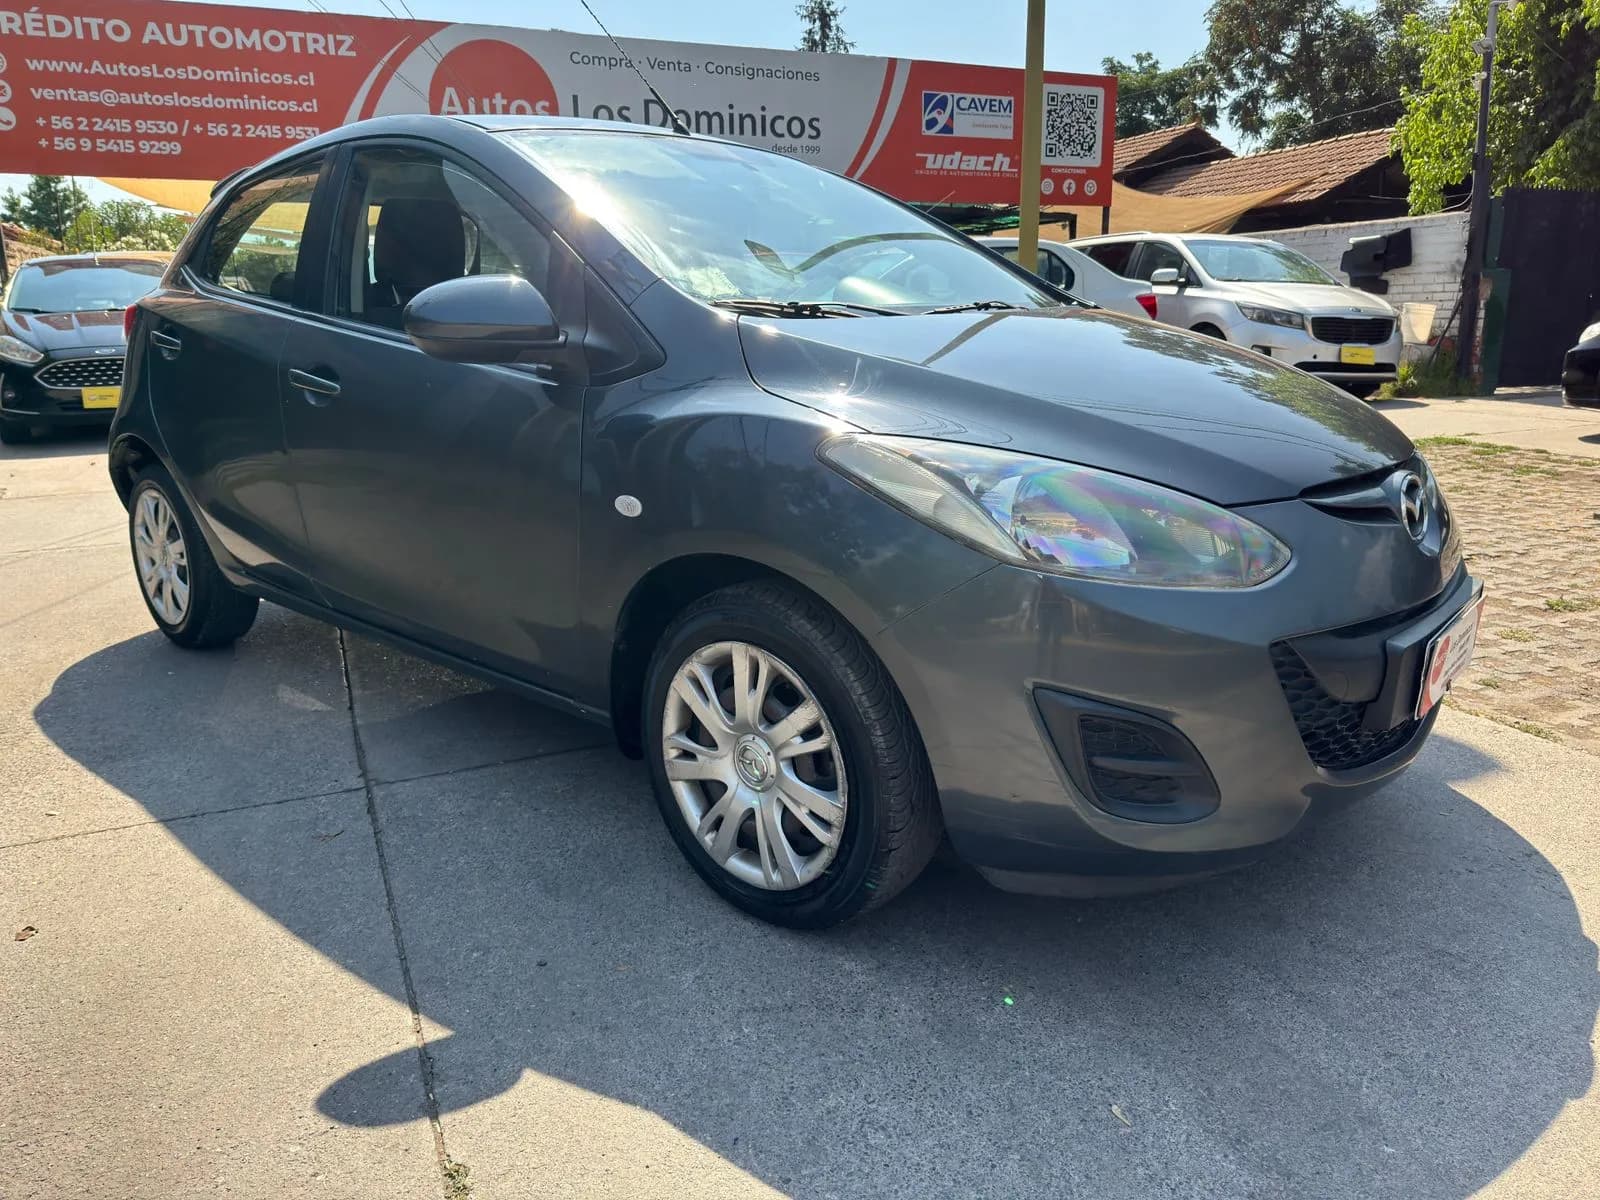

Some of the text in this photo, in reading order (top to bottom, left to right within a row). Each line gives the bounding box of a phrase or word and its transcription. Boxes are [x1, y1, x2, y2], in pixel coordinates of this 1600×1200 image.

[142, 22, 357, 57] AUTOMOTRIZ
[25, 58, 316, 86] www.AutosLosDominicos.cl
[570, 51, 634, 70] Compra
[647, 56, 692, 72] Venta
[705, 61, 821, 82] Consignaciones
[30, 87, 319, 113] ventas@autoslosdominicos.cl
[956, 96, 1012, 114] CAVEM
[440, 87, 551, 116] Autos
[643, 98, 822, 140] Dominicos
[51, 115, 75, 130] 56
[77, 117, 90, 131] 2
[92, 118, 133, 133] 2415
[135, 119, 179, 135] 9530
[207, 123, 229, 137] 56
[231, 124, 243, 137] 2
[245, 125, 282, 139] 2415
[53, 136, 77, 151] 56
[79, 138, 92, 152] 9
[96, 139, 136, 153] 5415
[138, 141, 182, 155] 9299
[771, 143, 821, 154] desde 1999
[915, 151, 1018, 172] udach
